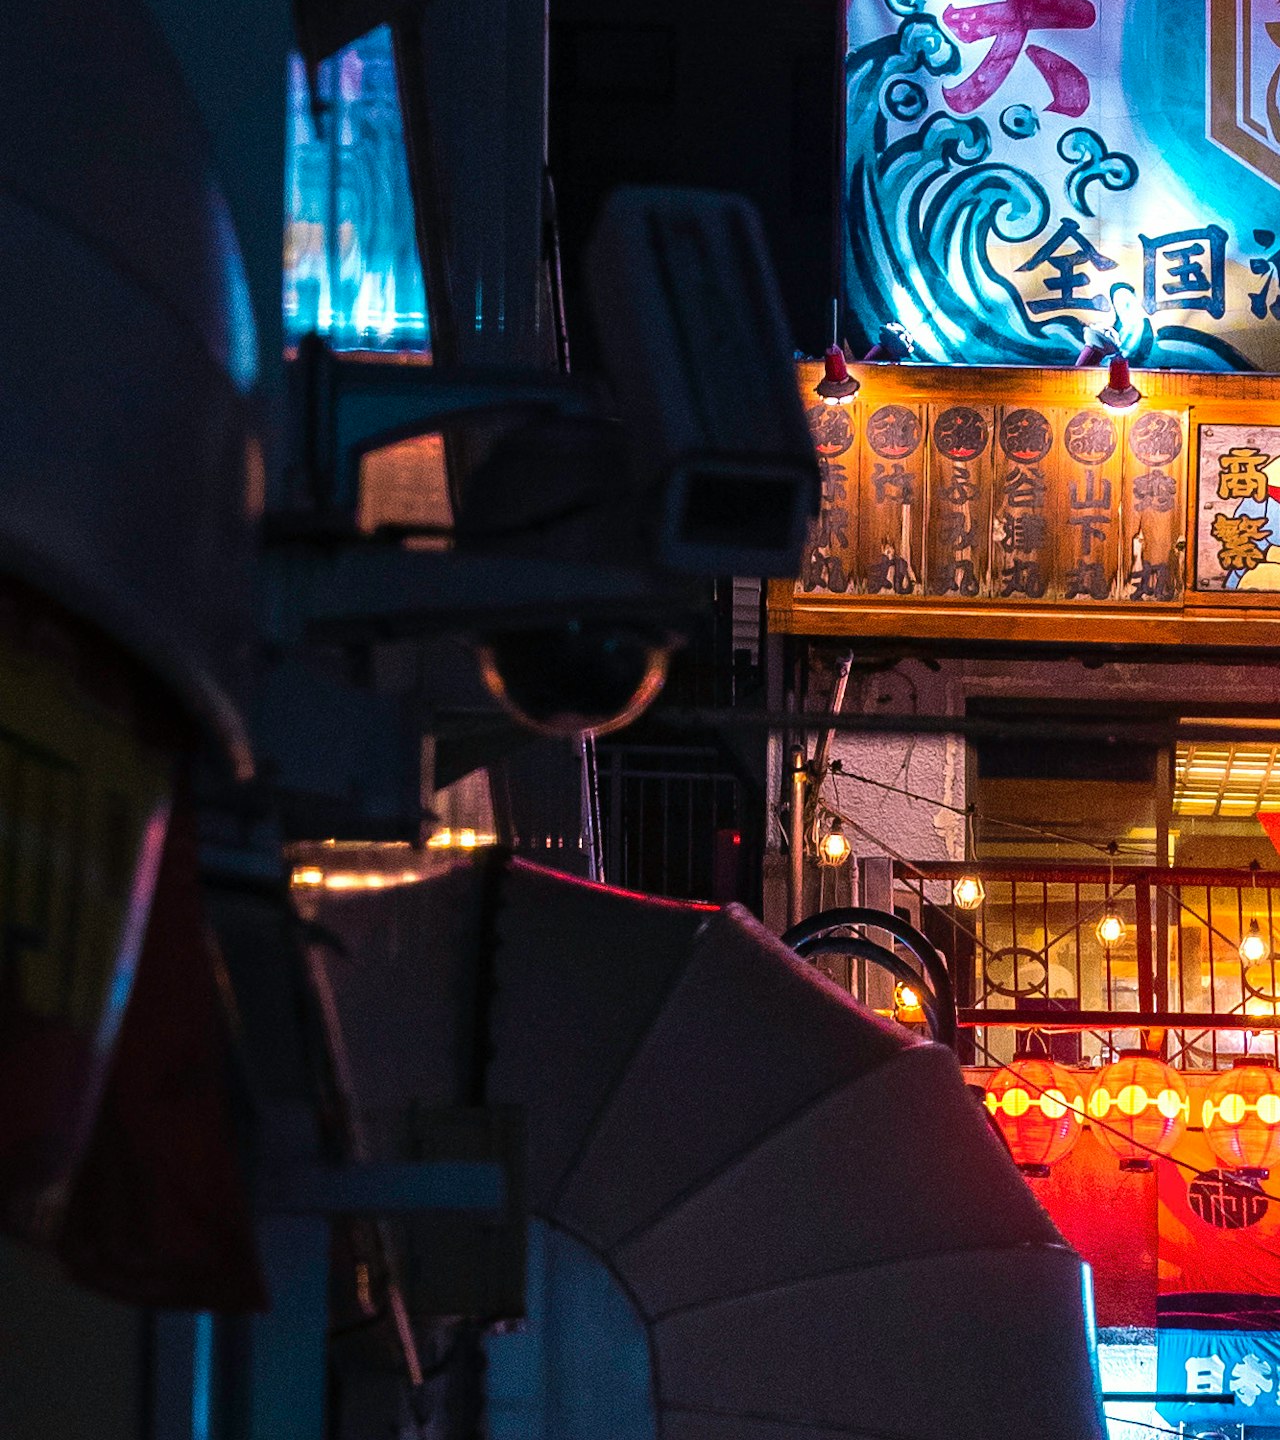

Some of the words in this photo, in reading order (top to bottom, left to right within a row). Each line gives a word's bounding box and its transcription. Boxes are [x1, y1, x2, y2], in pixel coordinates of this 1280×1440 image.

[1217, 448, 1269, 503] 商
[1064, 470, 1112, 600] 山下丸
